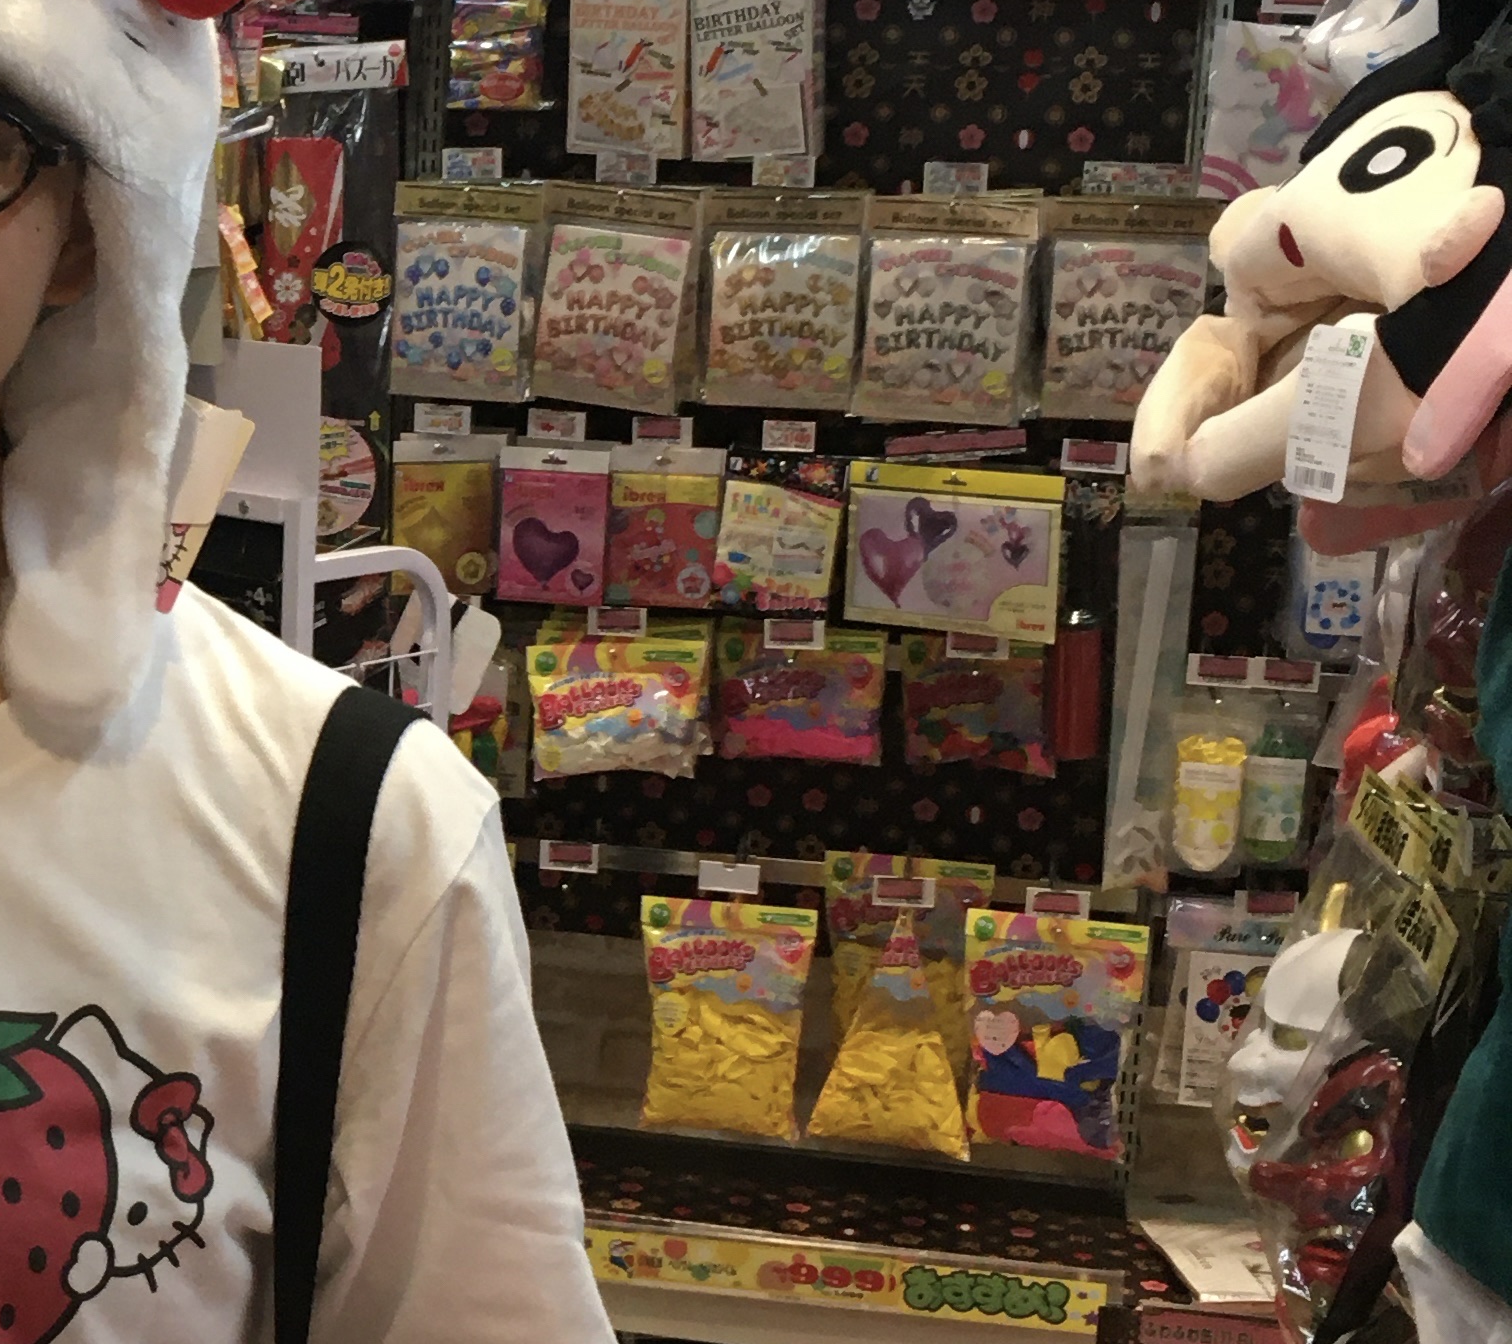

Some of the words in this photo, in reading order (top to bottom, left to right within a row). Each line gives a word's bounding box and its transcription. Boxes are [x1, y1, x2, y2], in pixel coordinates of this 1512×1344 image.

[693, 0, 783, 32] BIRTHDAY
[696, 22, 744, 43] LETTER
[745, 11, 806, 33] BALLOON
[415, 284, 495, 311] HAPPY
[566, 289, 653, 319] HAPPY
[738, 291, 828, 317] HAPPY
[400, 309, 512, 341] BIRTHDAY
[894, 301, 989, 330] HAPPY
[1076, 301, 1176, 330] HAPPY
[546, 314, 668, 351] BIRTHDAY
[720, 317, 847, 349] BIRTHDAY
[874, 328, 1004, 362] BIRTHDAY
[1056, 328, 1173, 357] BIRTHDA
[900, 1263, 1071, 1325] おすすめ!
